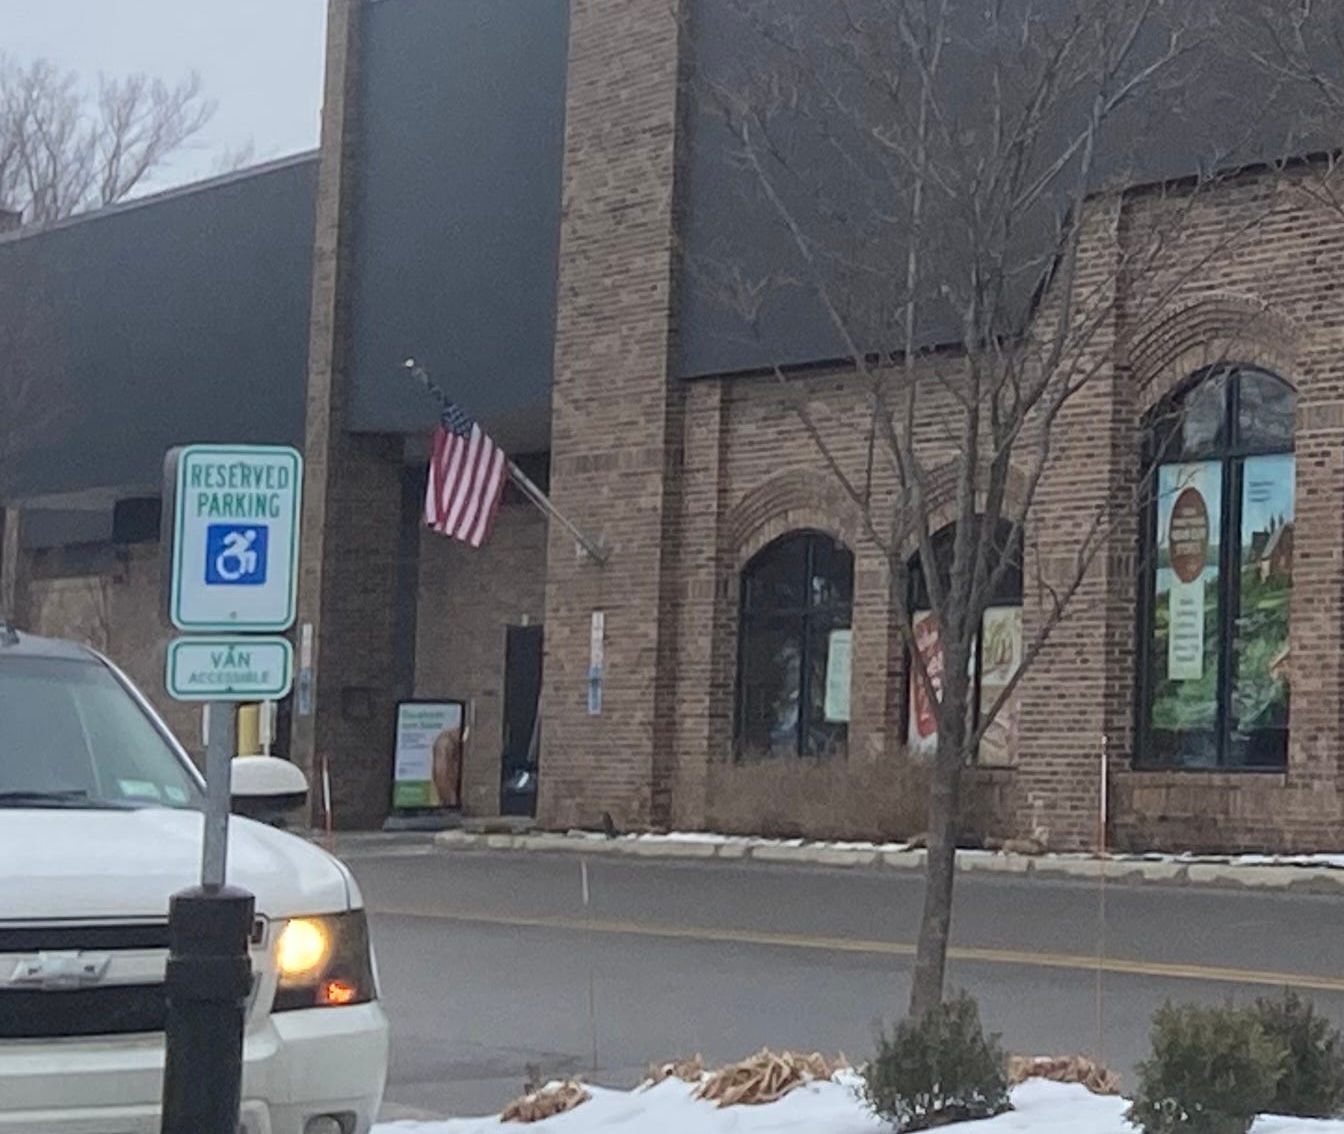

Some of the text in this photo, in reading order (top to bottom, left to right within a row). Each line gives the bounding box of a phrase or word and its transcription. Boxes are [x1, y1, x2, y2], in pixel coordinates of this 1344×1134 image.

[190, 463, 290, 490] RESERVED
[196, 492, 281, 519] PARKING
[210, 651, 251, 669] VAN
[187, 670, 270, 685] ACCESSIBLE
